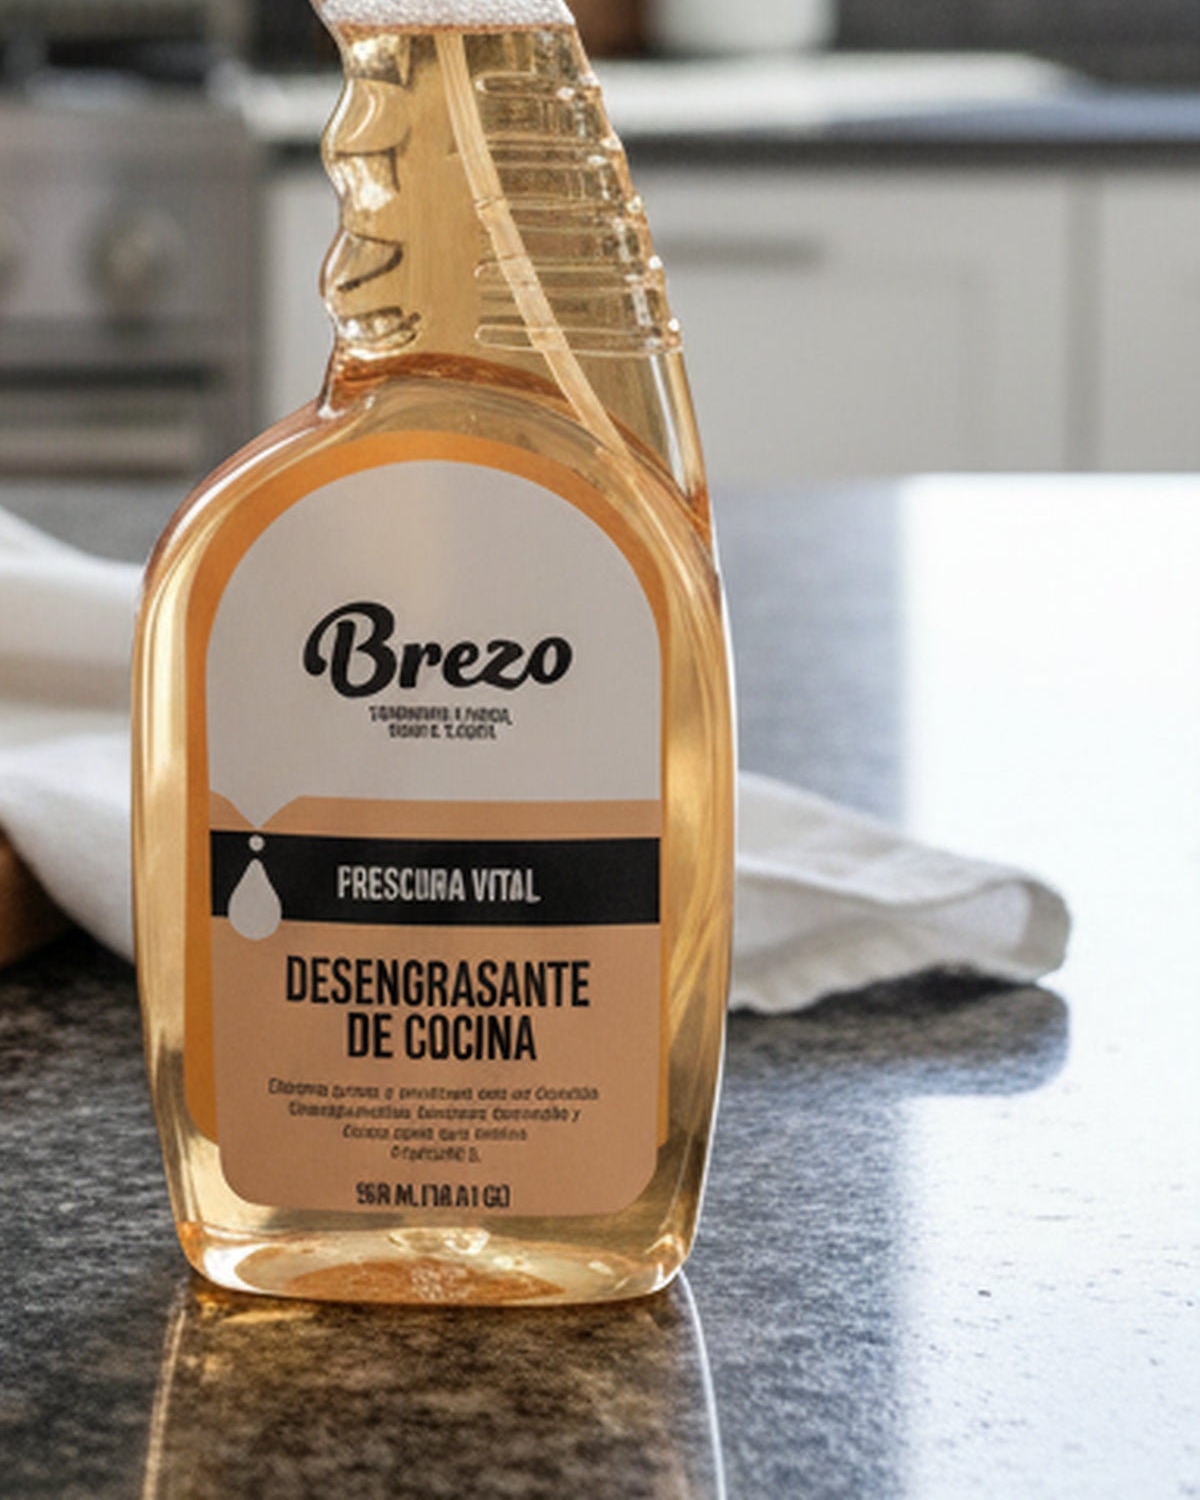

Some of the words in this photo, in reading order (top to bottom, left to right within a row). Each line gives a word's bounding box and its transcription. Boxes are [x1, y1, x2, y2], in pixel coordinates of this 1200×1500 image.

[303, 601, 573, 699] Brezo
[337, 864, 466, 902] FRESCURA
[471, 868, 542, 904] VITAL
[286, 955, 591, 1008] DESENGRASANTE
[347, 1012, 394, 1059] DE
[405, 1013, 538, 1061] COCINA
